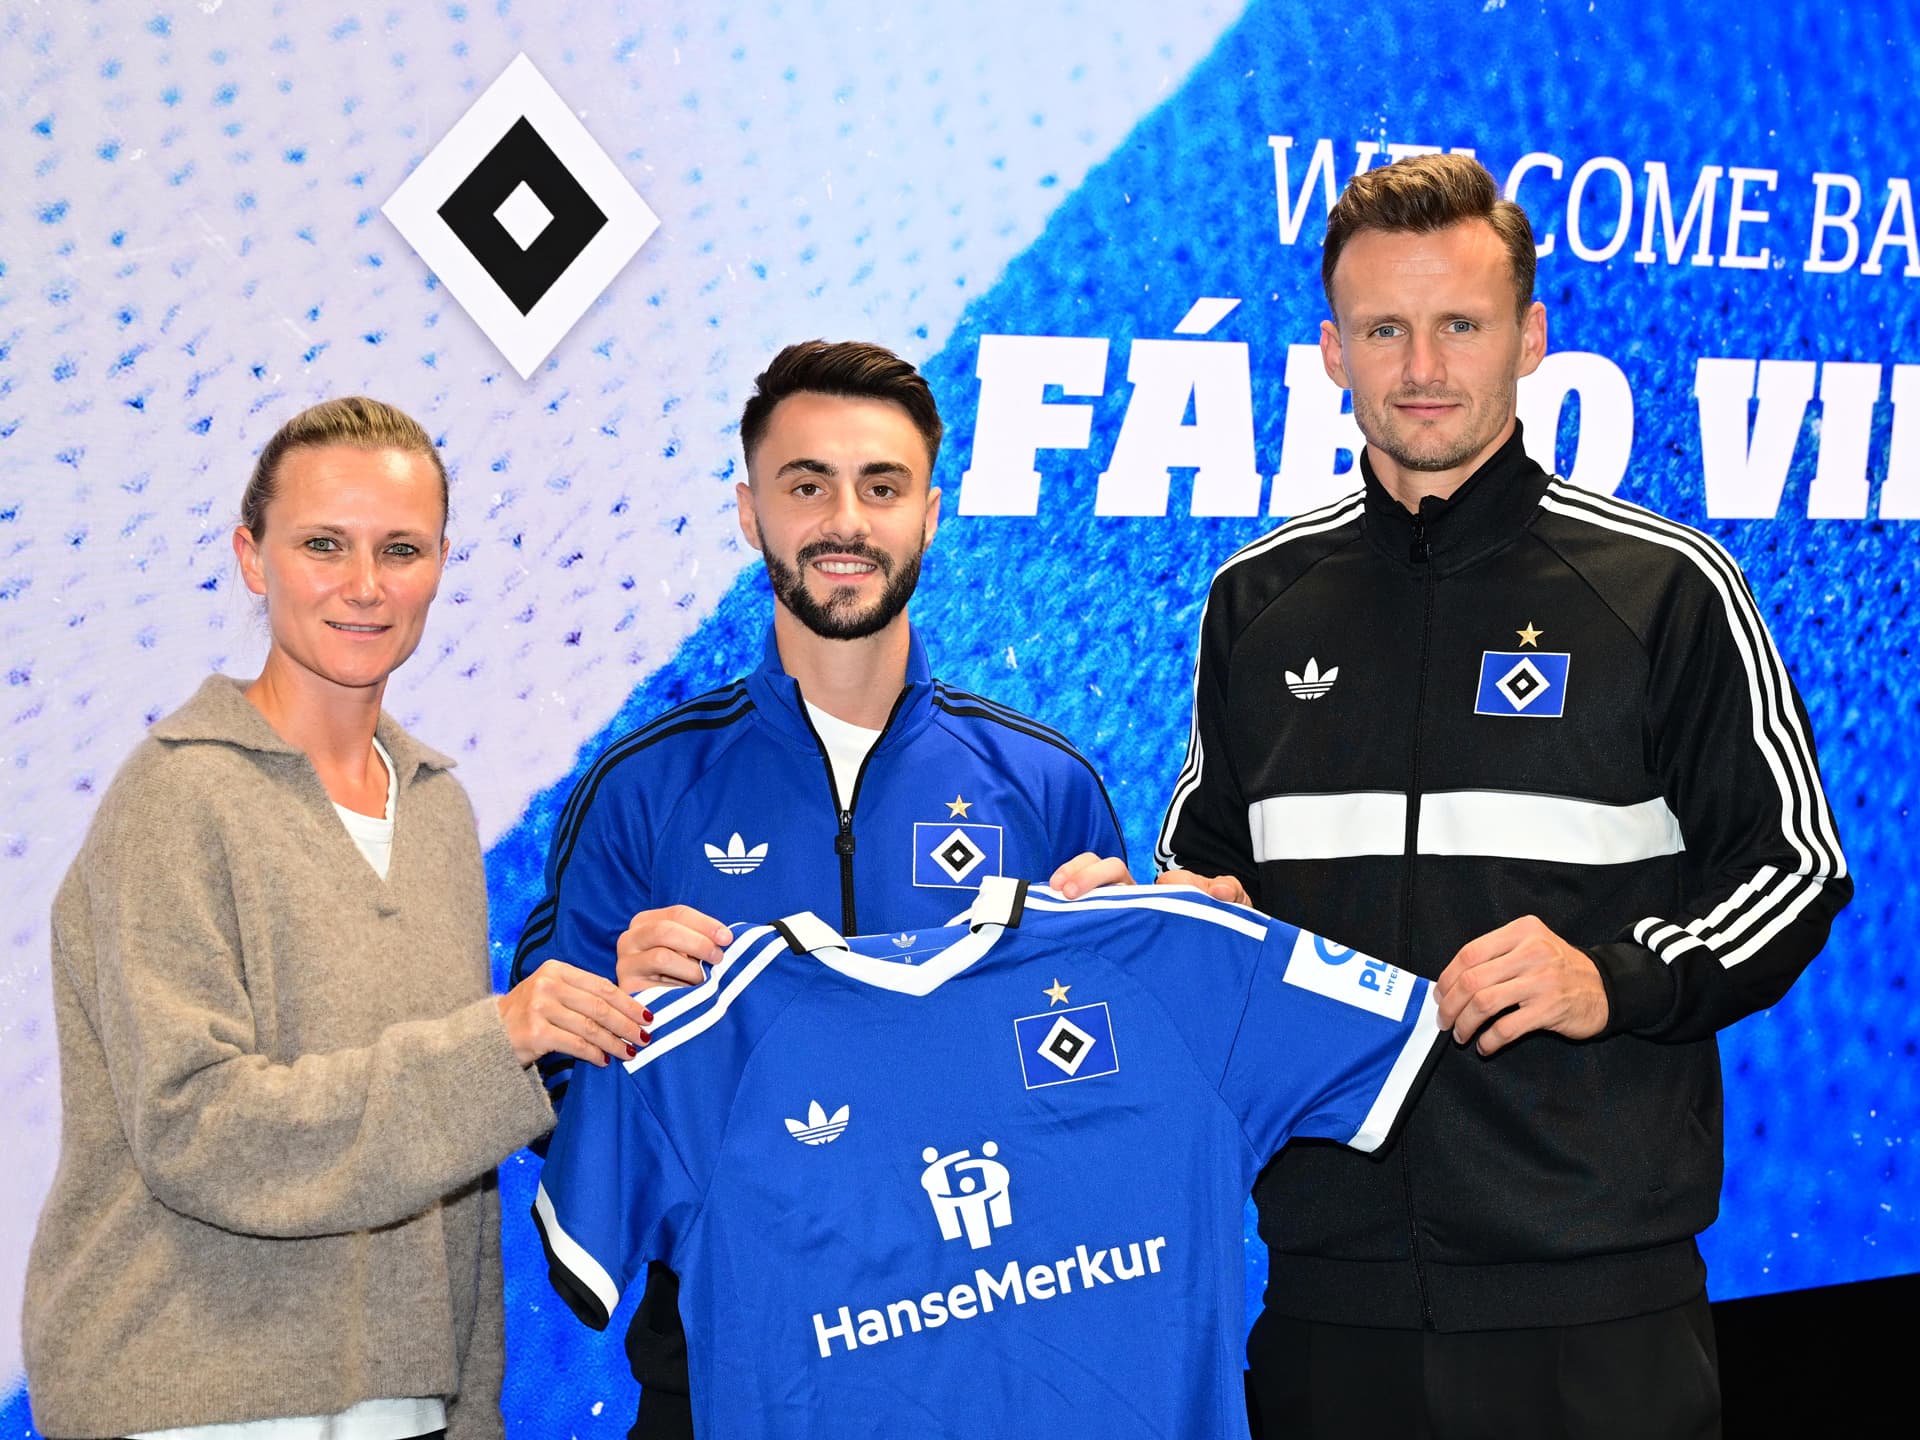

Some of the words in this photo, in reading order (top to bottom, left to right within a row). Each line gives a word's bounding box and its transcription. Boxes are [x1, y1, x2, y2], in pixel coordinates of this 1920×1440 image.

[1268, 135, 1778, 269] WCOME
[1803, 172, 1920, 277] BA
[958, 297, 1634, 517] FÁBO
[1359, 960, 1388, 992] PL
[812, 1236, 1166, 1358] HanseMerkur
